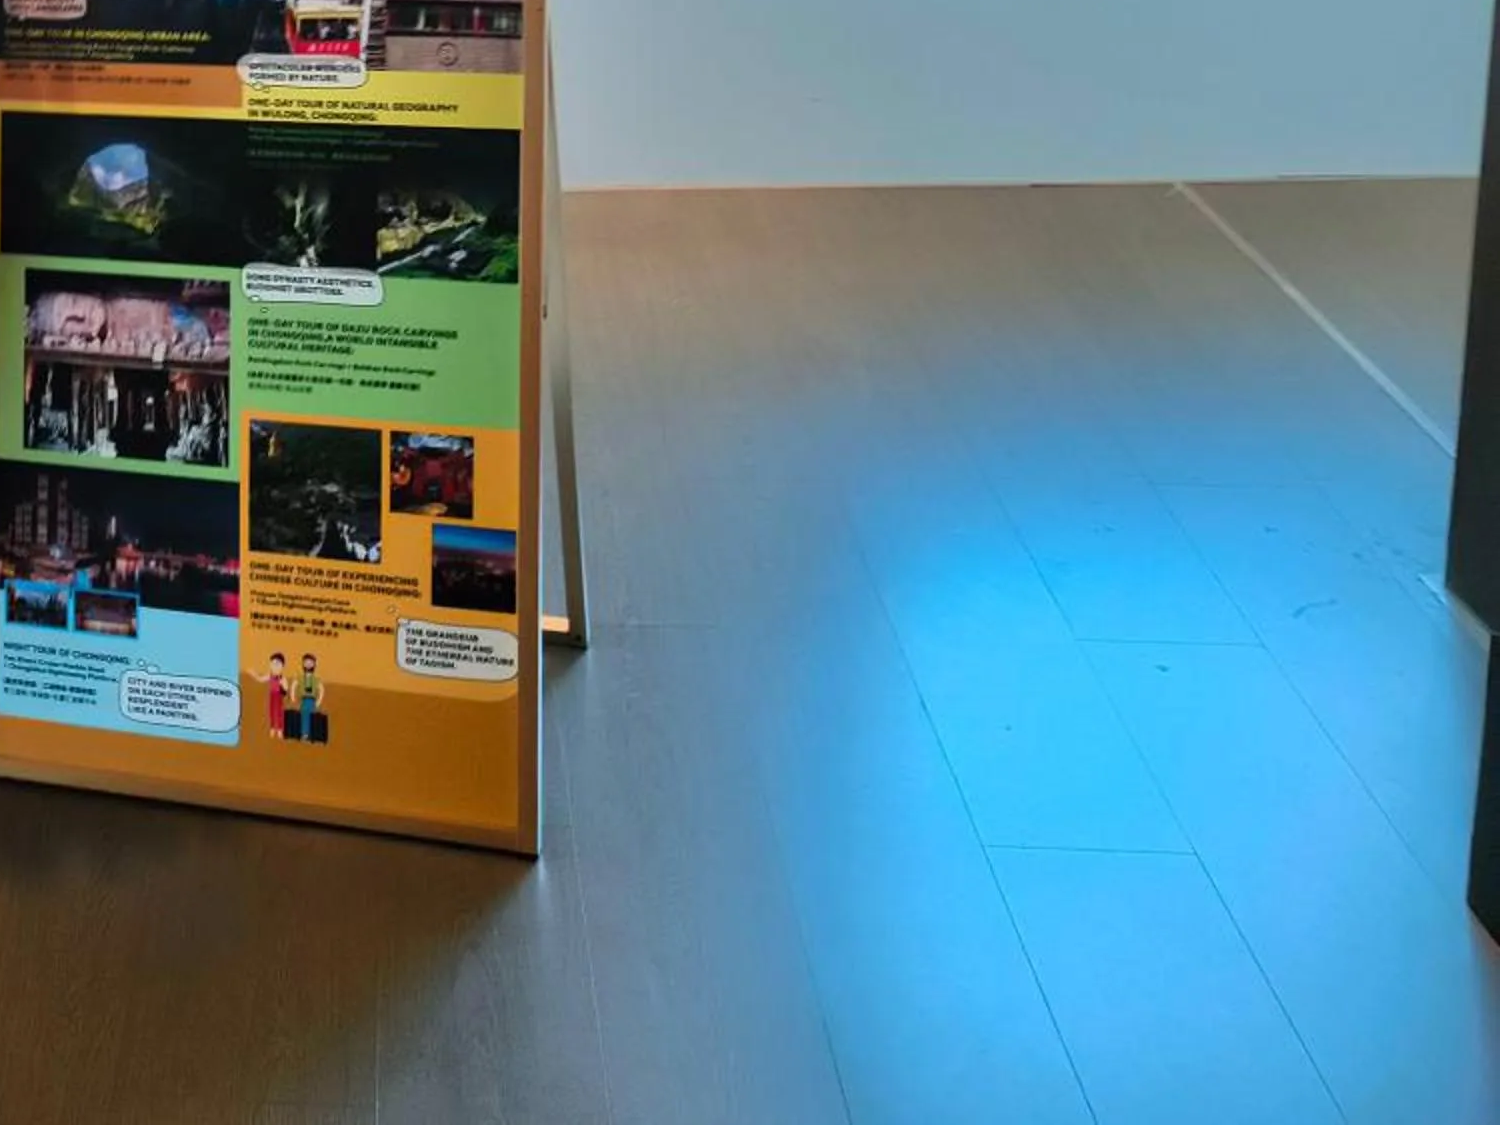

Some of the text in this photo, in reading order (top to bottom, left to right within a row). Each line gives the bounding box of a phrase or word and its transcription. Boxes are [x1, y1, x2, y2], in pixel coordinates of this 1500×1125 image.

[406, 628, 479, 642] THE GRANDEUR
[405, 637, 494, 654] OF BUDDHISM AND
[405, 657, 417, 665] OF
[406, 646, 515, 667] THE ETHEREAL NATURE
[127, 676, 233, 698] CITY AND RIVER DEPEND
[127, 686, 141, 694] ON
[142, 688, 166, 698] EACH
[127, 705, 147, 715] LIKE
[148, 707, 155, 715] A
